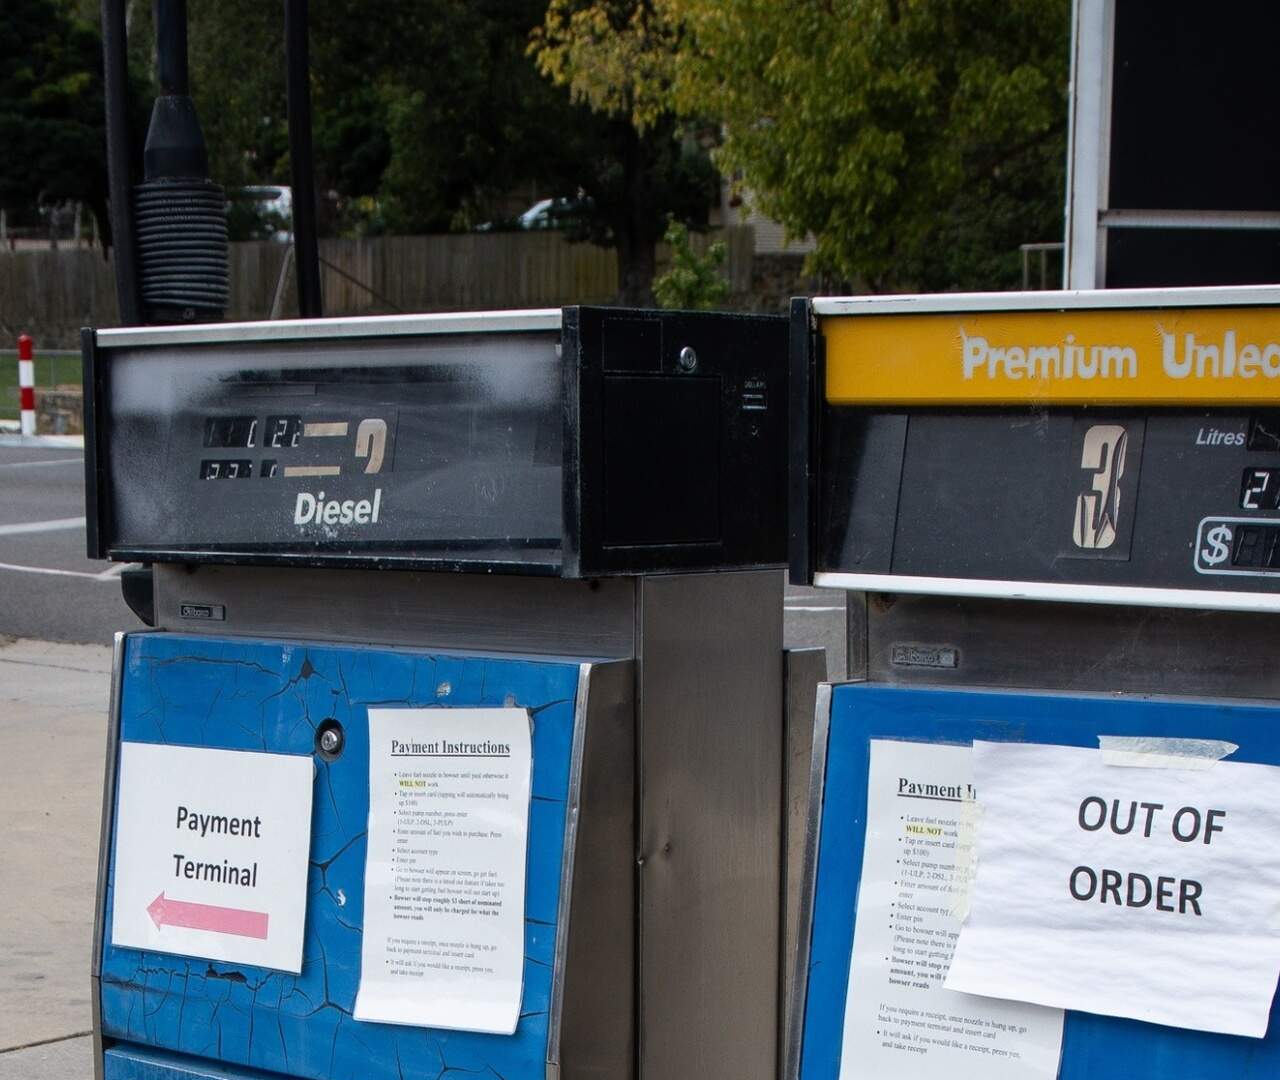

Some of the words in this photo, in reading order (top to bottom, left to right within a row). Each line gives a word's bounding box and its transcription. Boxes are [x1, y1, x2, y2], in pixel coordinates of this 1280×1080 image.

[962, 334, 1138, 380] Premium
[1196, 428, 1246, 446] Litres
[1072, 425, 1126, 549] 3
[294, 489, 382, 524] Diesel
[392, 740, 438, 754] Payment
[443, 740, 510, 754] Instructions
[898, 778, 961, 798] Payment
[176, 806, 262, 840] Payment
[906, 825, 924, 833] WILL
[926, 827, 942, 836] NOT
[1078, 796, 1164, 838] OUT
[1172, 806, 1226, 845] OF
[173, 854, 257, 888] Terminal
[1069, 865, 1203, 916] ORDER
